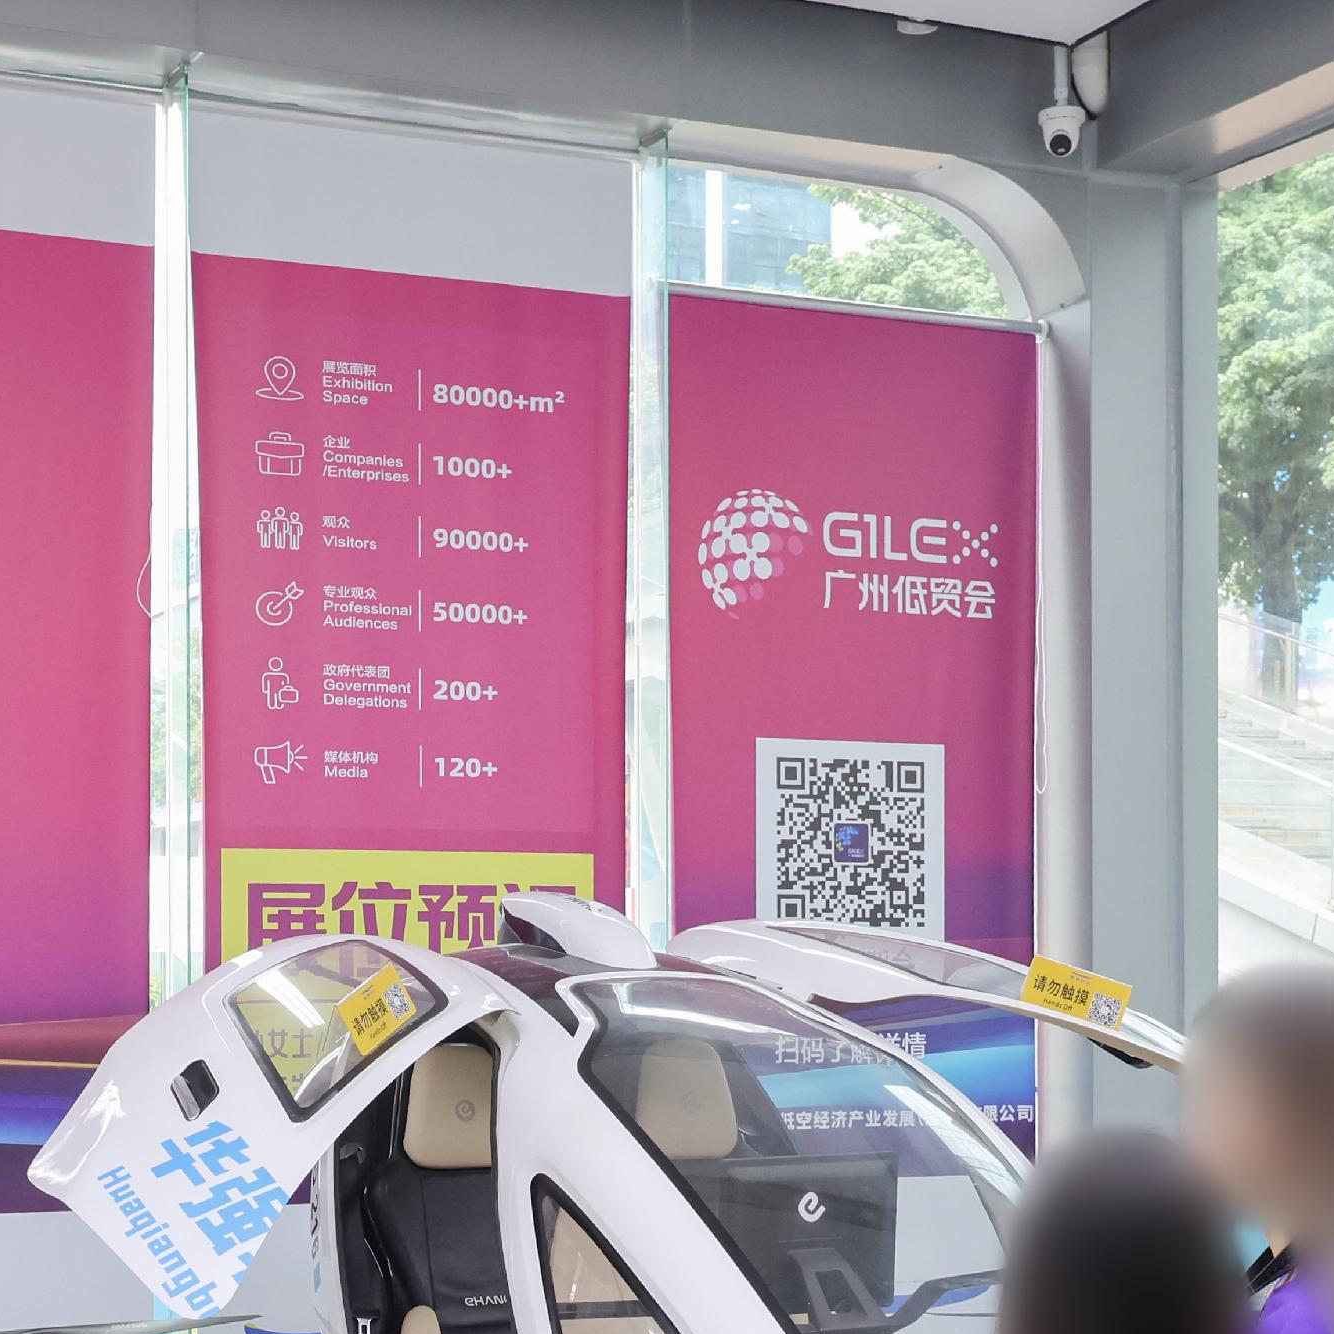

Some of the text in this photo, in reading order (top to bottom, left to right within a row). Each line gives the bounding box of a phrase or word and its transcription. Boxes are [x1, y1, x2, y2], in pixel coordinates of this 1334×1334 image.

[322, 360, 377, 377] 展览面积
[322, 375, 393, 393] Exhibition
[322, 390, 369, 406] Space
[322, 434, 351, 449] 企业
[322, 450, 404, 468] Companies
[432, 455, 513, 479] 1000+
[322, 465, 410, 483] /Enterprises
[322, 515, 351, 529] 观众
[322, 535, 378, 550] Visitors
[432, 528, 529, 553] 90000+
[822, 510, 999, 568] GILEX
[323, 585, 377, 600] 专业观众
[822, 569, 996, 619] 广州低贸会
[322, 600, 412, 617] Professional
[432, 601, 528, 625] 50000+
[322, 615, 398, 630] Audiences
[322, 663, 390, 679] 政府代表团
[322, 678, 412, 695] Government
[432, 679, 498, 702] 200+
[322, 693, 408, 709] Delegations
[323, 750, 379, 765] 媒体机构
[323, 764, 369, 779] Media
[433, 757, 498, 779] 120+
[247, 880, 576, 968] 展位预
[1033, 974, 1090, 1006] 请勿触摸
[97, 1165, 220, 1320] Huaqiangb
